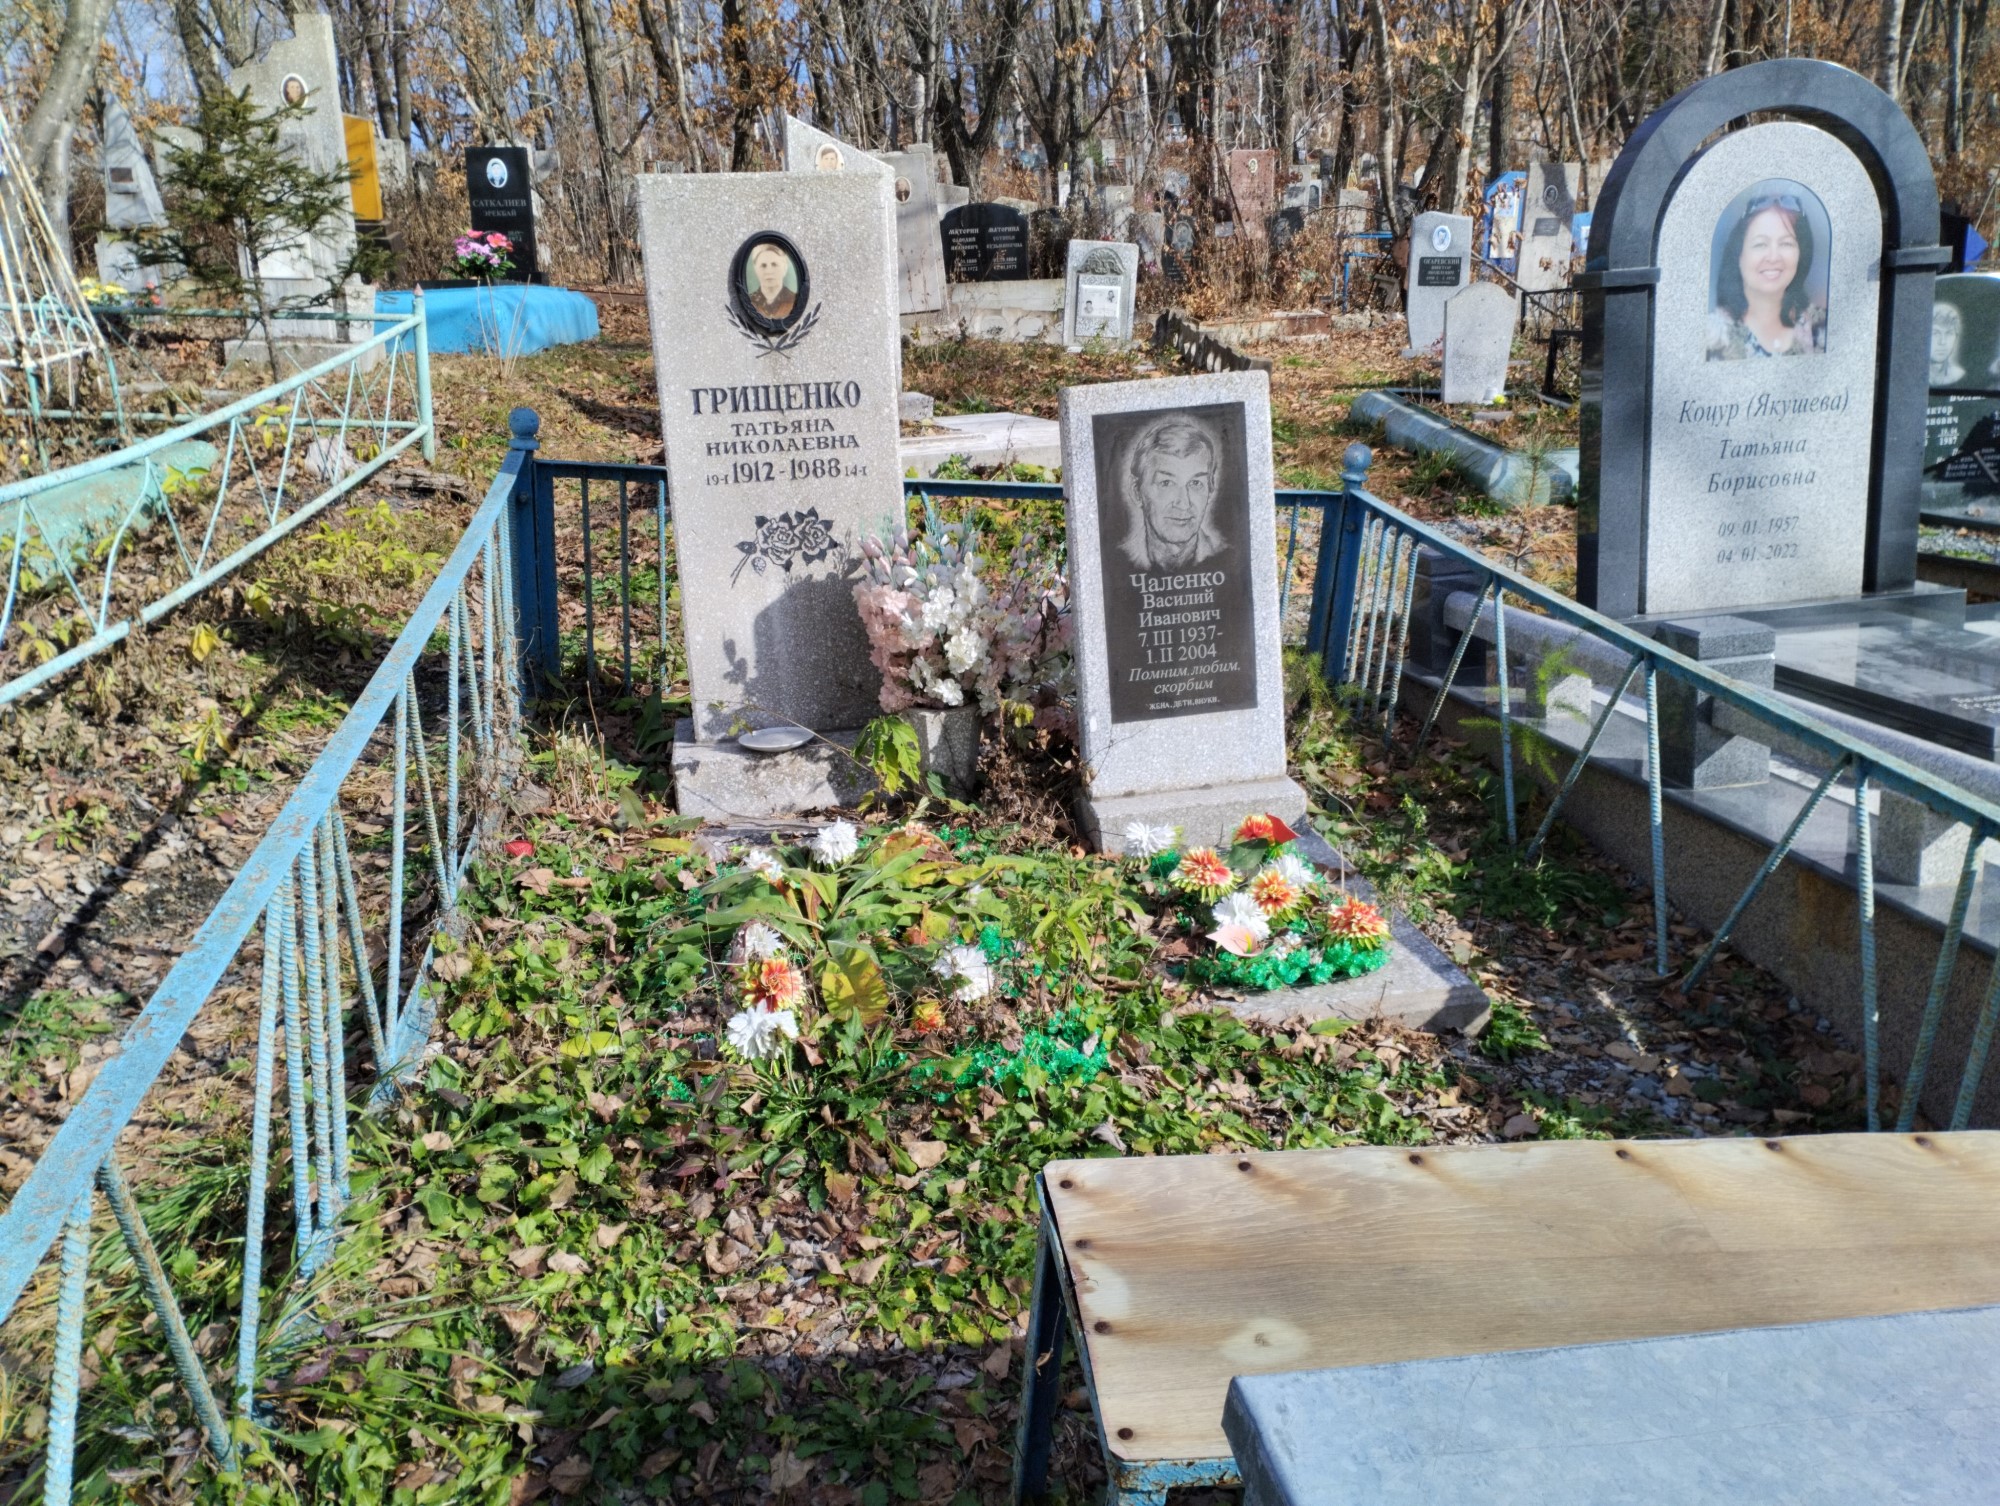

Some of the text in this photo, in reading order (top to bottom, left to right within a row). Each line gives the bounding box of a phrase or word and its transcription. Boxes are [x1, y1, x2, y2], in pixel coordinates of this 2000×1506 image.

[472, 199, 527, 207] САТКАЛИЕВ
[948, 227, 979, 235] МАТОРИН
[690, 380, 861, 416] ГРИЩЕНКО
[1678, 387, 1849, 427] Коцур (Якушева)
[731, 418, 835, 437] ТАТЬЯНА
[705, 434, 860, 457] НИКОЛАЕВНА
[1719, 438, 1807, 460] Татьяна
[732, 459, 775, 484] 1912
[790, 457, 841, 481] 1988
[1707, 469, 1816, 496] Борисовна
[1767, 515, 1800, 534] 1957
[1765, 543, 1799, 560] 2022
[1129, 570, 1226, 594] Чаленко
[1142, 588, 1215, 609] Василий
[1138, 609, 1221, 628] Иванович
[1153, 629, 1173, 646] III
[1160, 647, 1173, 663] II
[1178, 643, 1217, 661] 2004
[1154, 678, 1213, 695] скорбим
